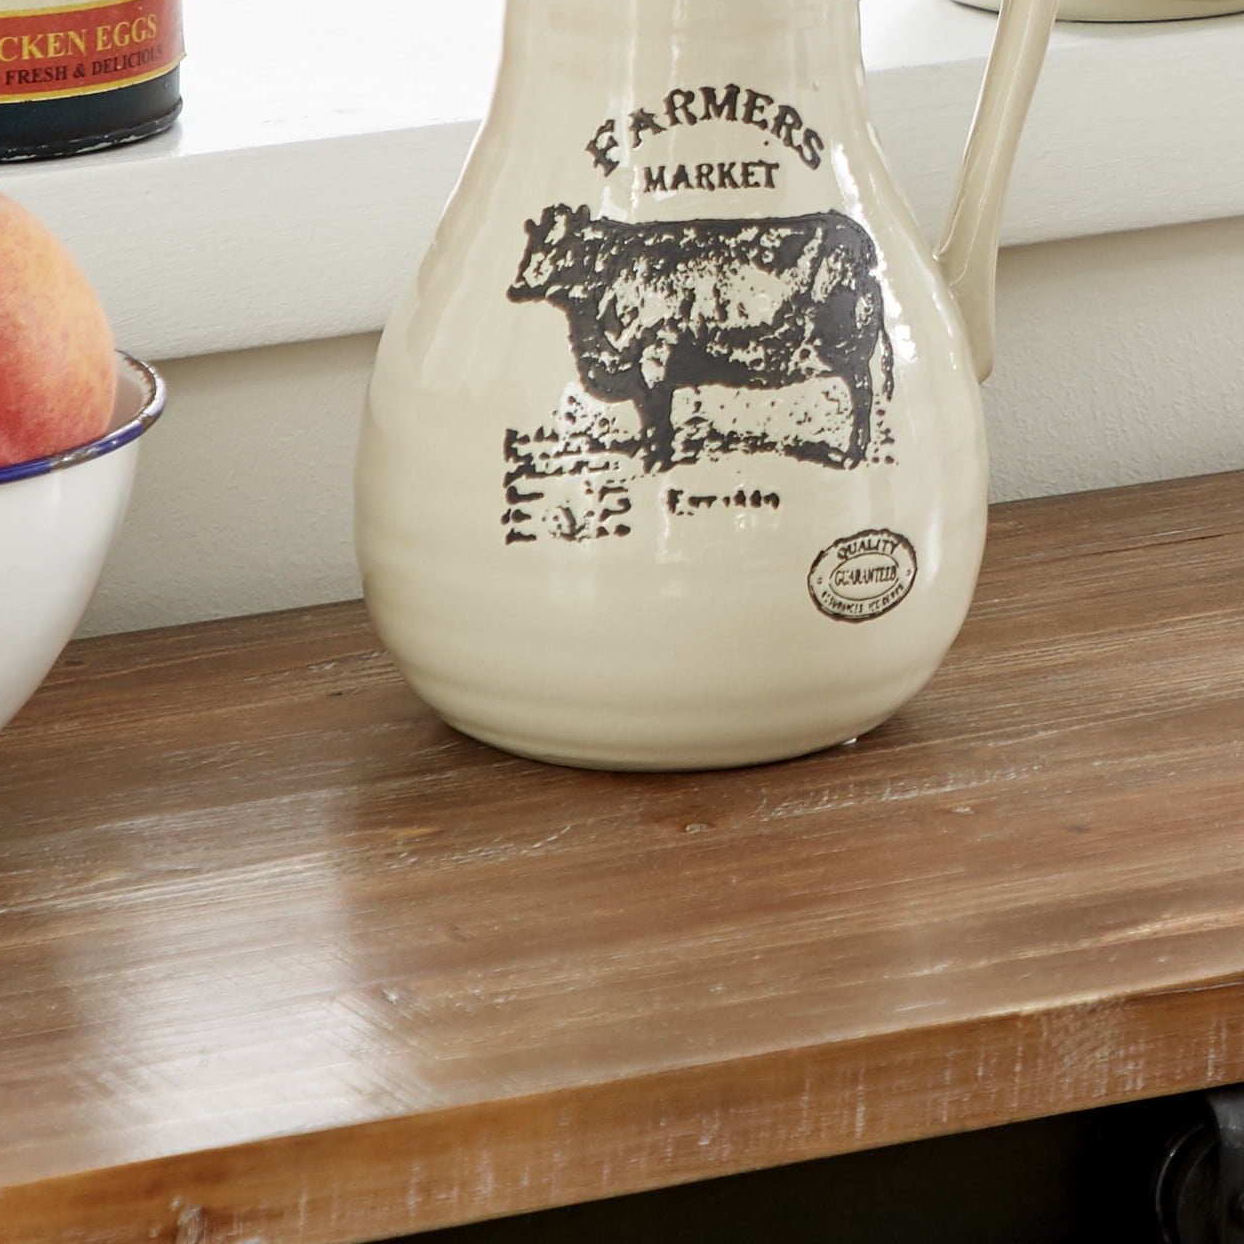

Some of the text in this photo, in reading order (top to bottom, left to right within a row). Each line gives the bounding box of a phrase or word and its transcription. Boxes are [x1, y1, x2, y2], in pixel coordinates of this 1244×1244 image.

[96, 13, 157, 51] EGGS
[5, 64, 68, 86] FRESH
[73, 62, 86, 79] &
[585, 83, 825, 177] FARMERS
[643, 159, 780, 193] MARKET
[837, 538, 903, 560] QUALITY
